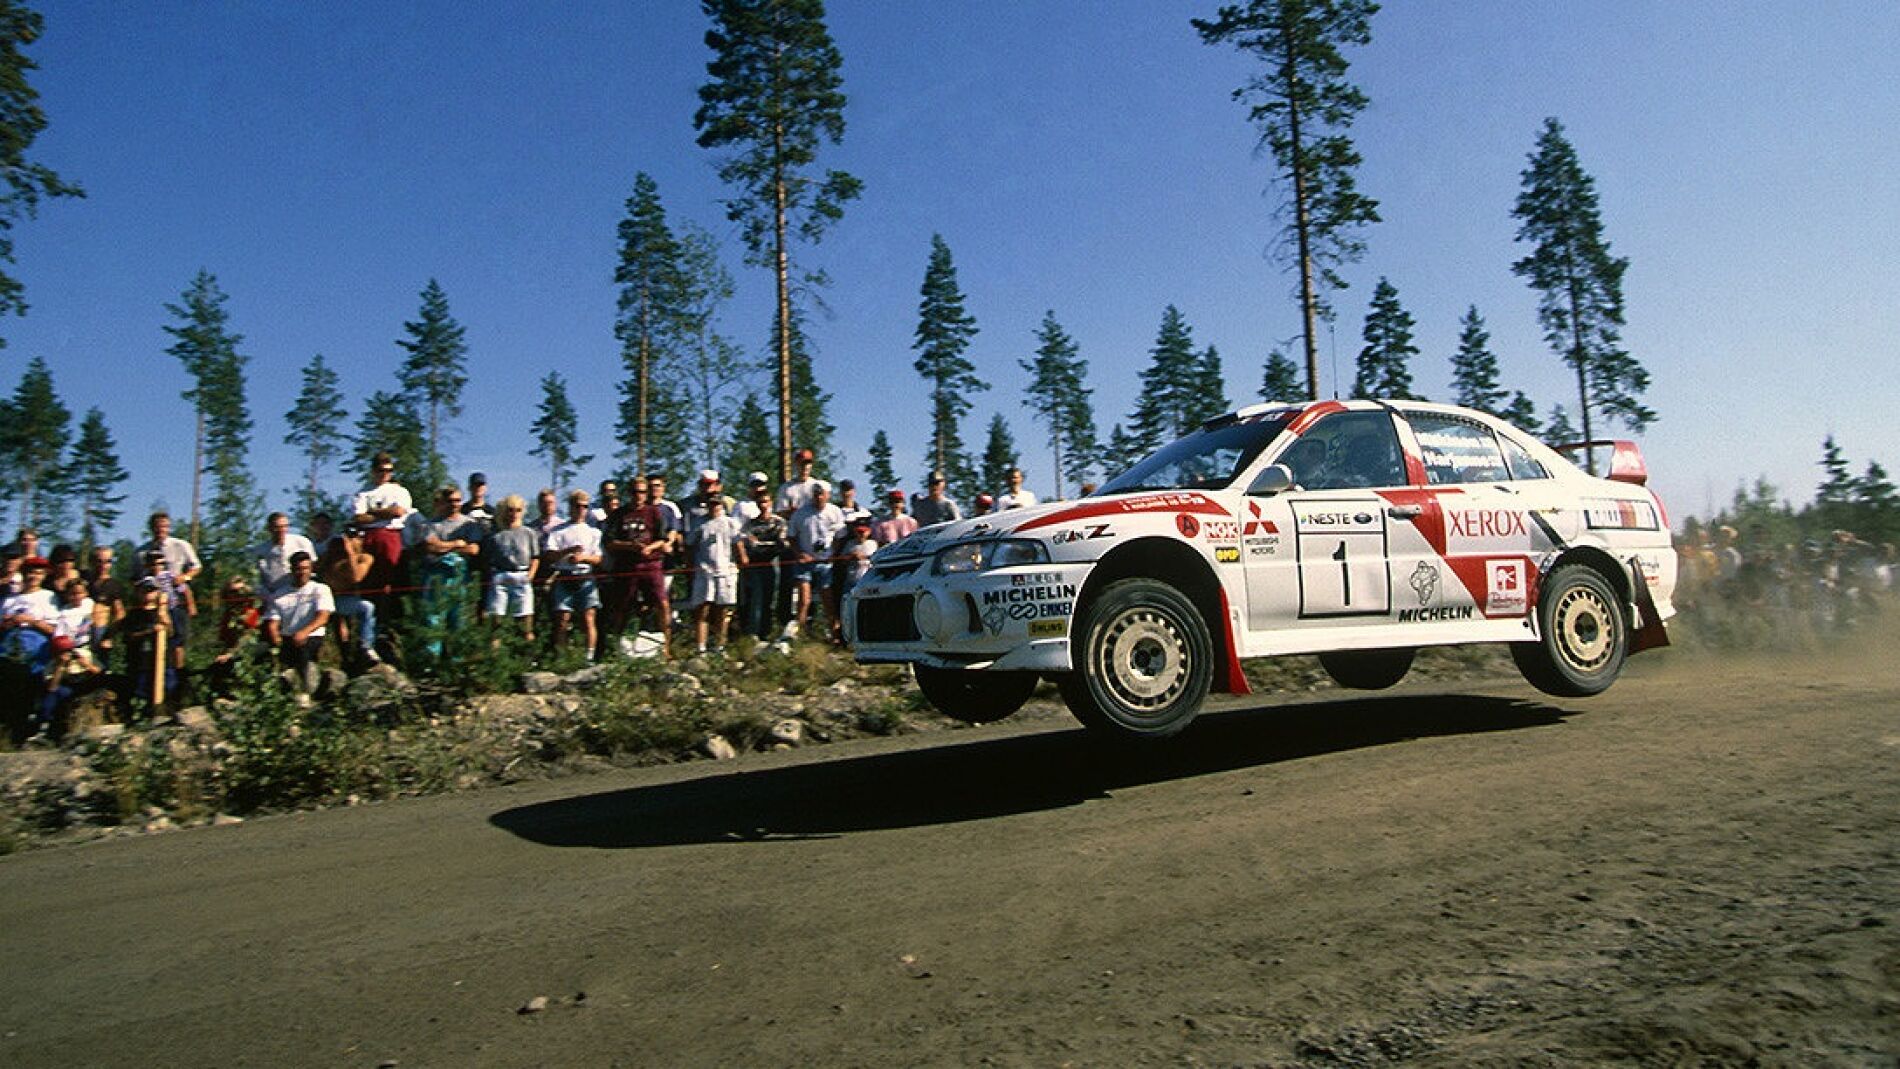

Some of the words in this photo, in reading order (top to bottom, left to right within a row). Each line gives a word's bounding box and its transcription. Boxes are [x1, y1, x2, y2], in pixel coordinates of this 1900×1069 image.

[1308, 513, 1351, 525] NESTE
[1448, 509, 1527, 537] XEROX
[1332, 540, 1351, 606] 1
[983, 585, 1076, 604] MICHELIN
[1398, 605, 1473, 622] MICHELIN
